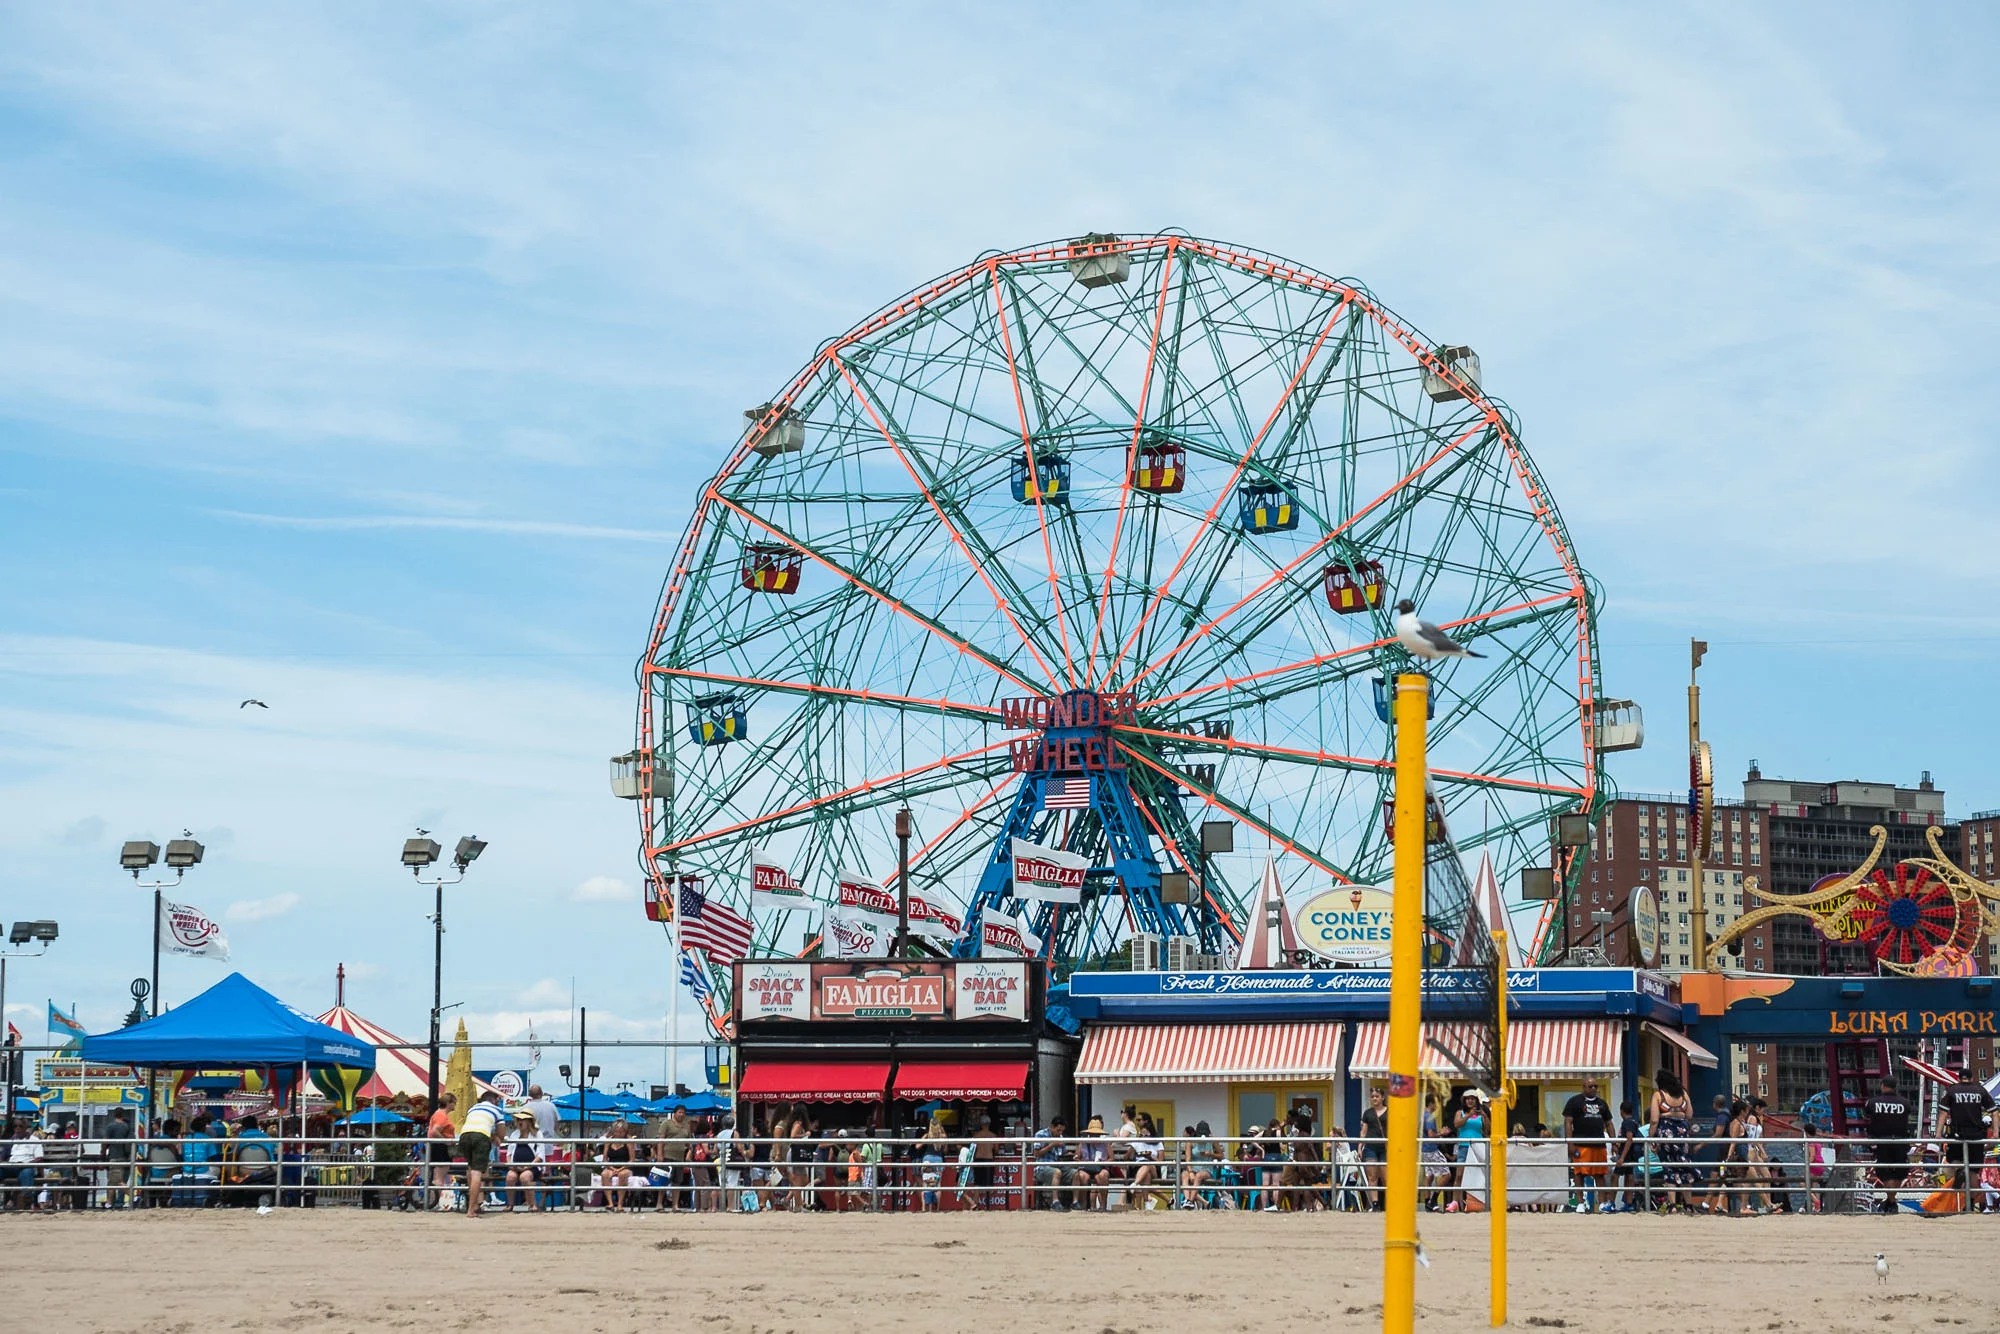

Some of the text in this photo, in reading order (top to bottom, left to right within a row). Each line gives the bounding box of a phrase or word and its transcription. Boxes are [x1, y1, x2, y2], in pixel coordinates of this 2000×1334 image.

[1001, 693, 1137, 730] WONDER
[1009, 736, 1127, 772] WHEEL
[756, 870, 801, 889] FAMIG
[1017, 862, 1080, 883] FAMIGLIA
[1321, 927, 1391, 941] CONES
[849, 933, 875, 953] 98
[761, 965, 792, 977] Deno's
[974, 964, 1006, 977] Deno's
[748, 978, 805, 991] SNACK
[962, 977, 1019, 991] SNACK
[1163, 974, 1215, 991] Fresh
[1215, 974, 1314, 992] Homemade
[1420, 973, 1458, 988] elato
[1462, 976, 1473, 988] &
[760, 992, 793, 1006] BAR
[825, 984, 938, 1006] FAMIGLIA
[973, 991, 1008, 1005] BAR
[861, 1007, 905, 1016] PIZZERIA
[1829, 1010, 1997, 1034] LUNA PARK
[1954, 1092, 1982, 1103] NYPD
[1875, 1102, 1905, 1114] NYPD
